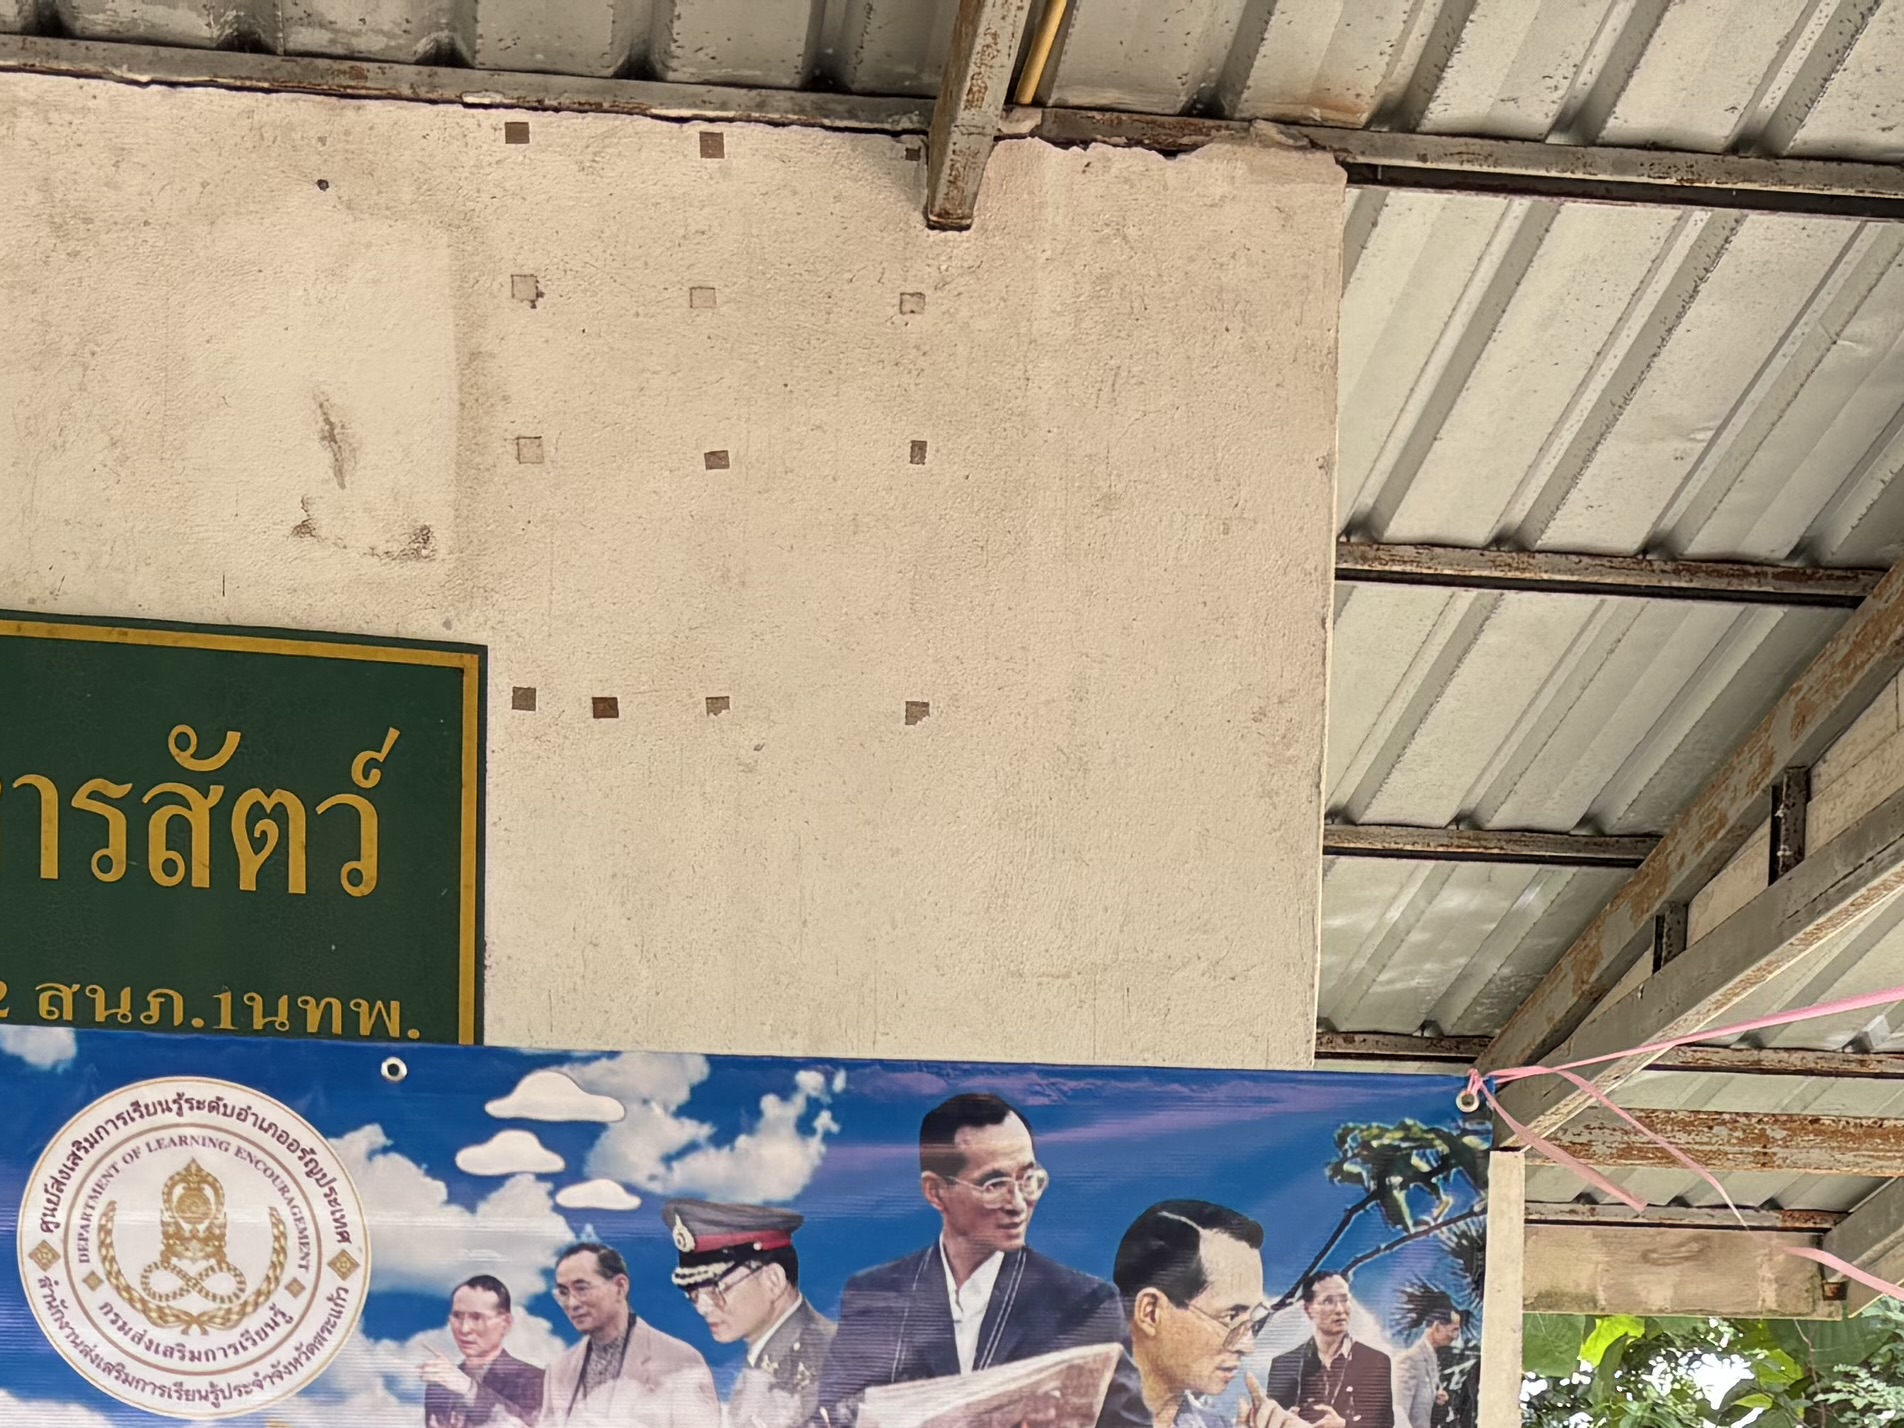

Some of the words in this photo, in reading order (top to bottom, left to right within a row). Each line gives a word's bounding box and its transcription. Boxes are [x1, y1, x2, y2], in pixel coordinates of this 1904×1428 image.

[77, 1161, 121, 1264] DEPARTMENT
[121, 1144, 143, 1167] OF
[145, 1134, 231, 1154] LEARNING
[233, 1147, 311, 1273] ENCOURAGEMENT
